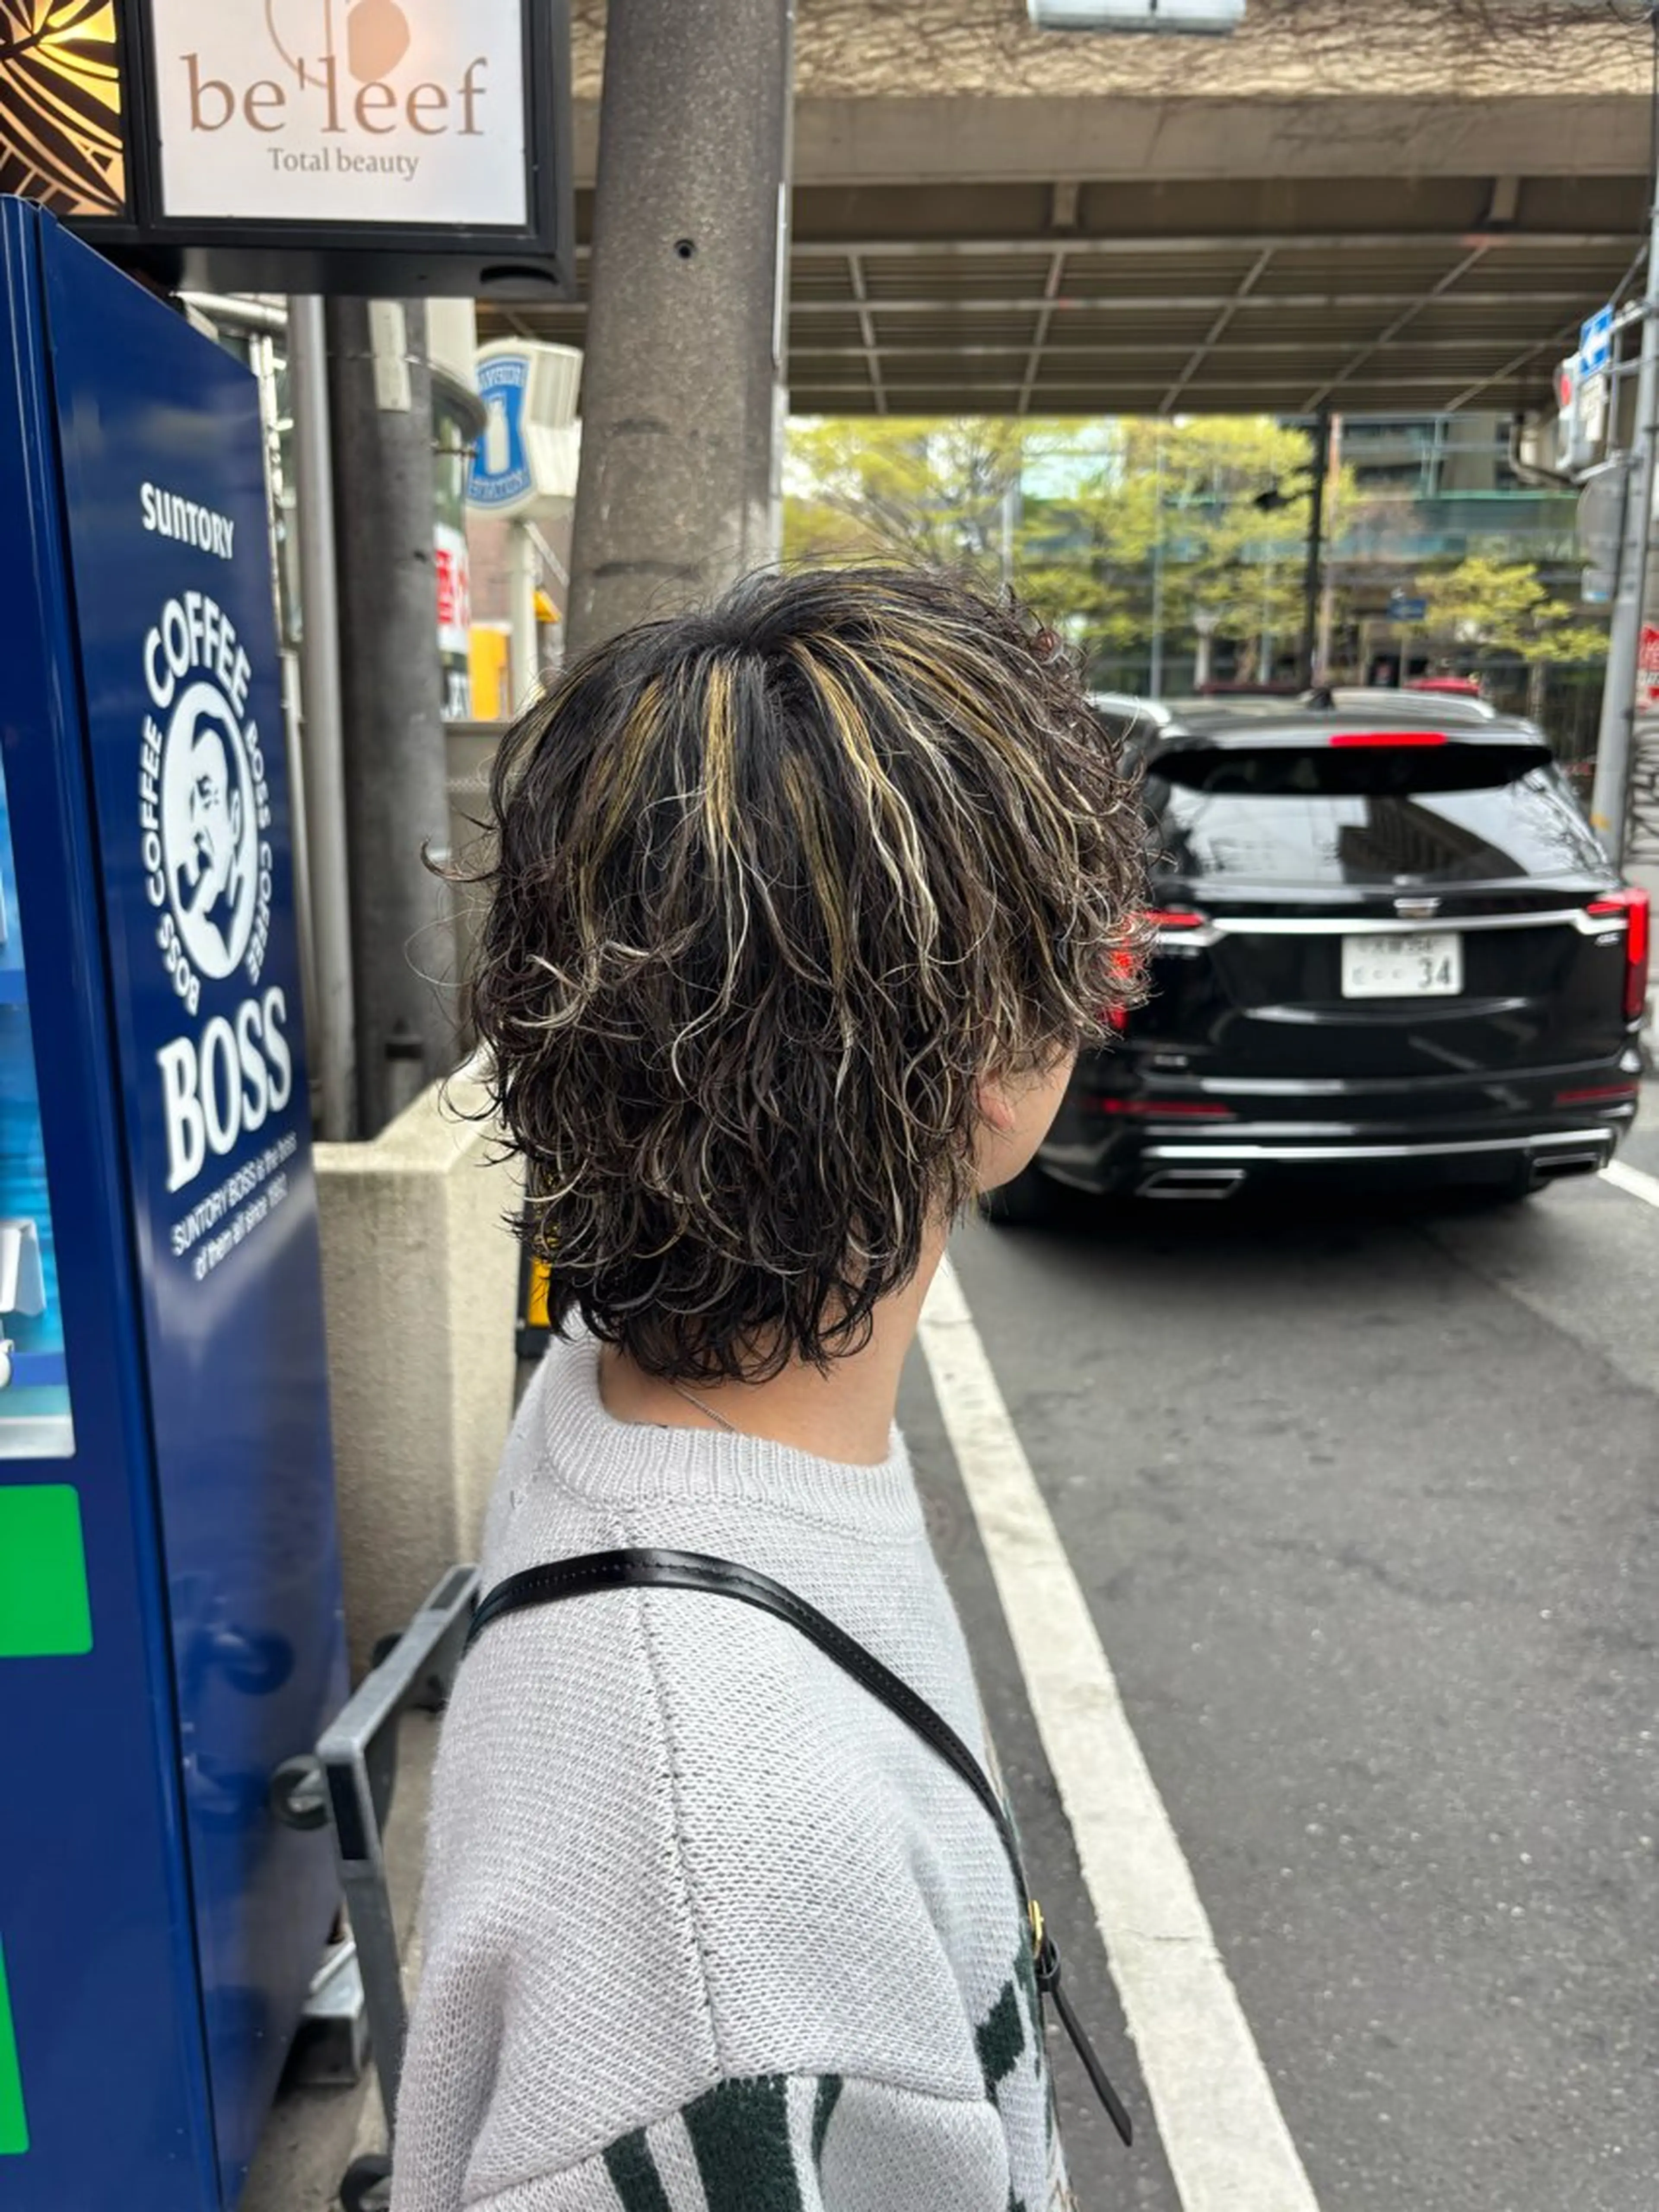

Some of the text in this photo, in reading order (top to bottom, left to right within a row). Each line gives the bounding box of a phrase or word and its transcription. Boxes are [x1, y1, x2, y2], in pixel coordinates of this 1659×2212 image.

[179, 53, 488, 137] be'leef
[268, 147, 420, 181] Total beauty
[143, 590, 252, 718] COFFEE
[139, 715, 200, 1017] BOSS COFFEE
[244, 719, 273, 986] BOSS COFFEE
[156, 985, 292, 1192] BOSS
[171, 1186, 228, 1256] SUNTORY
